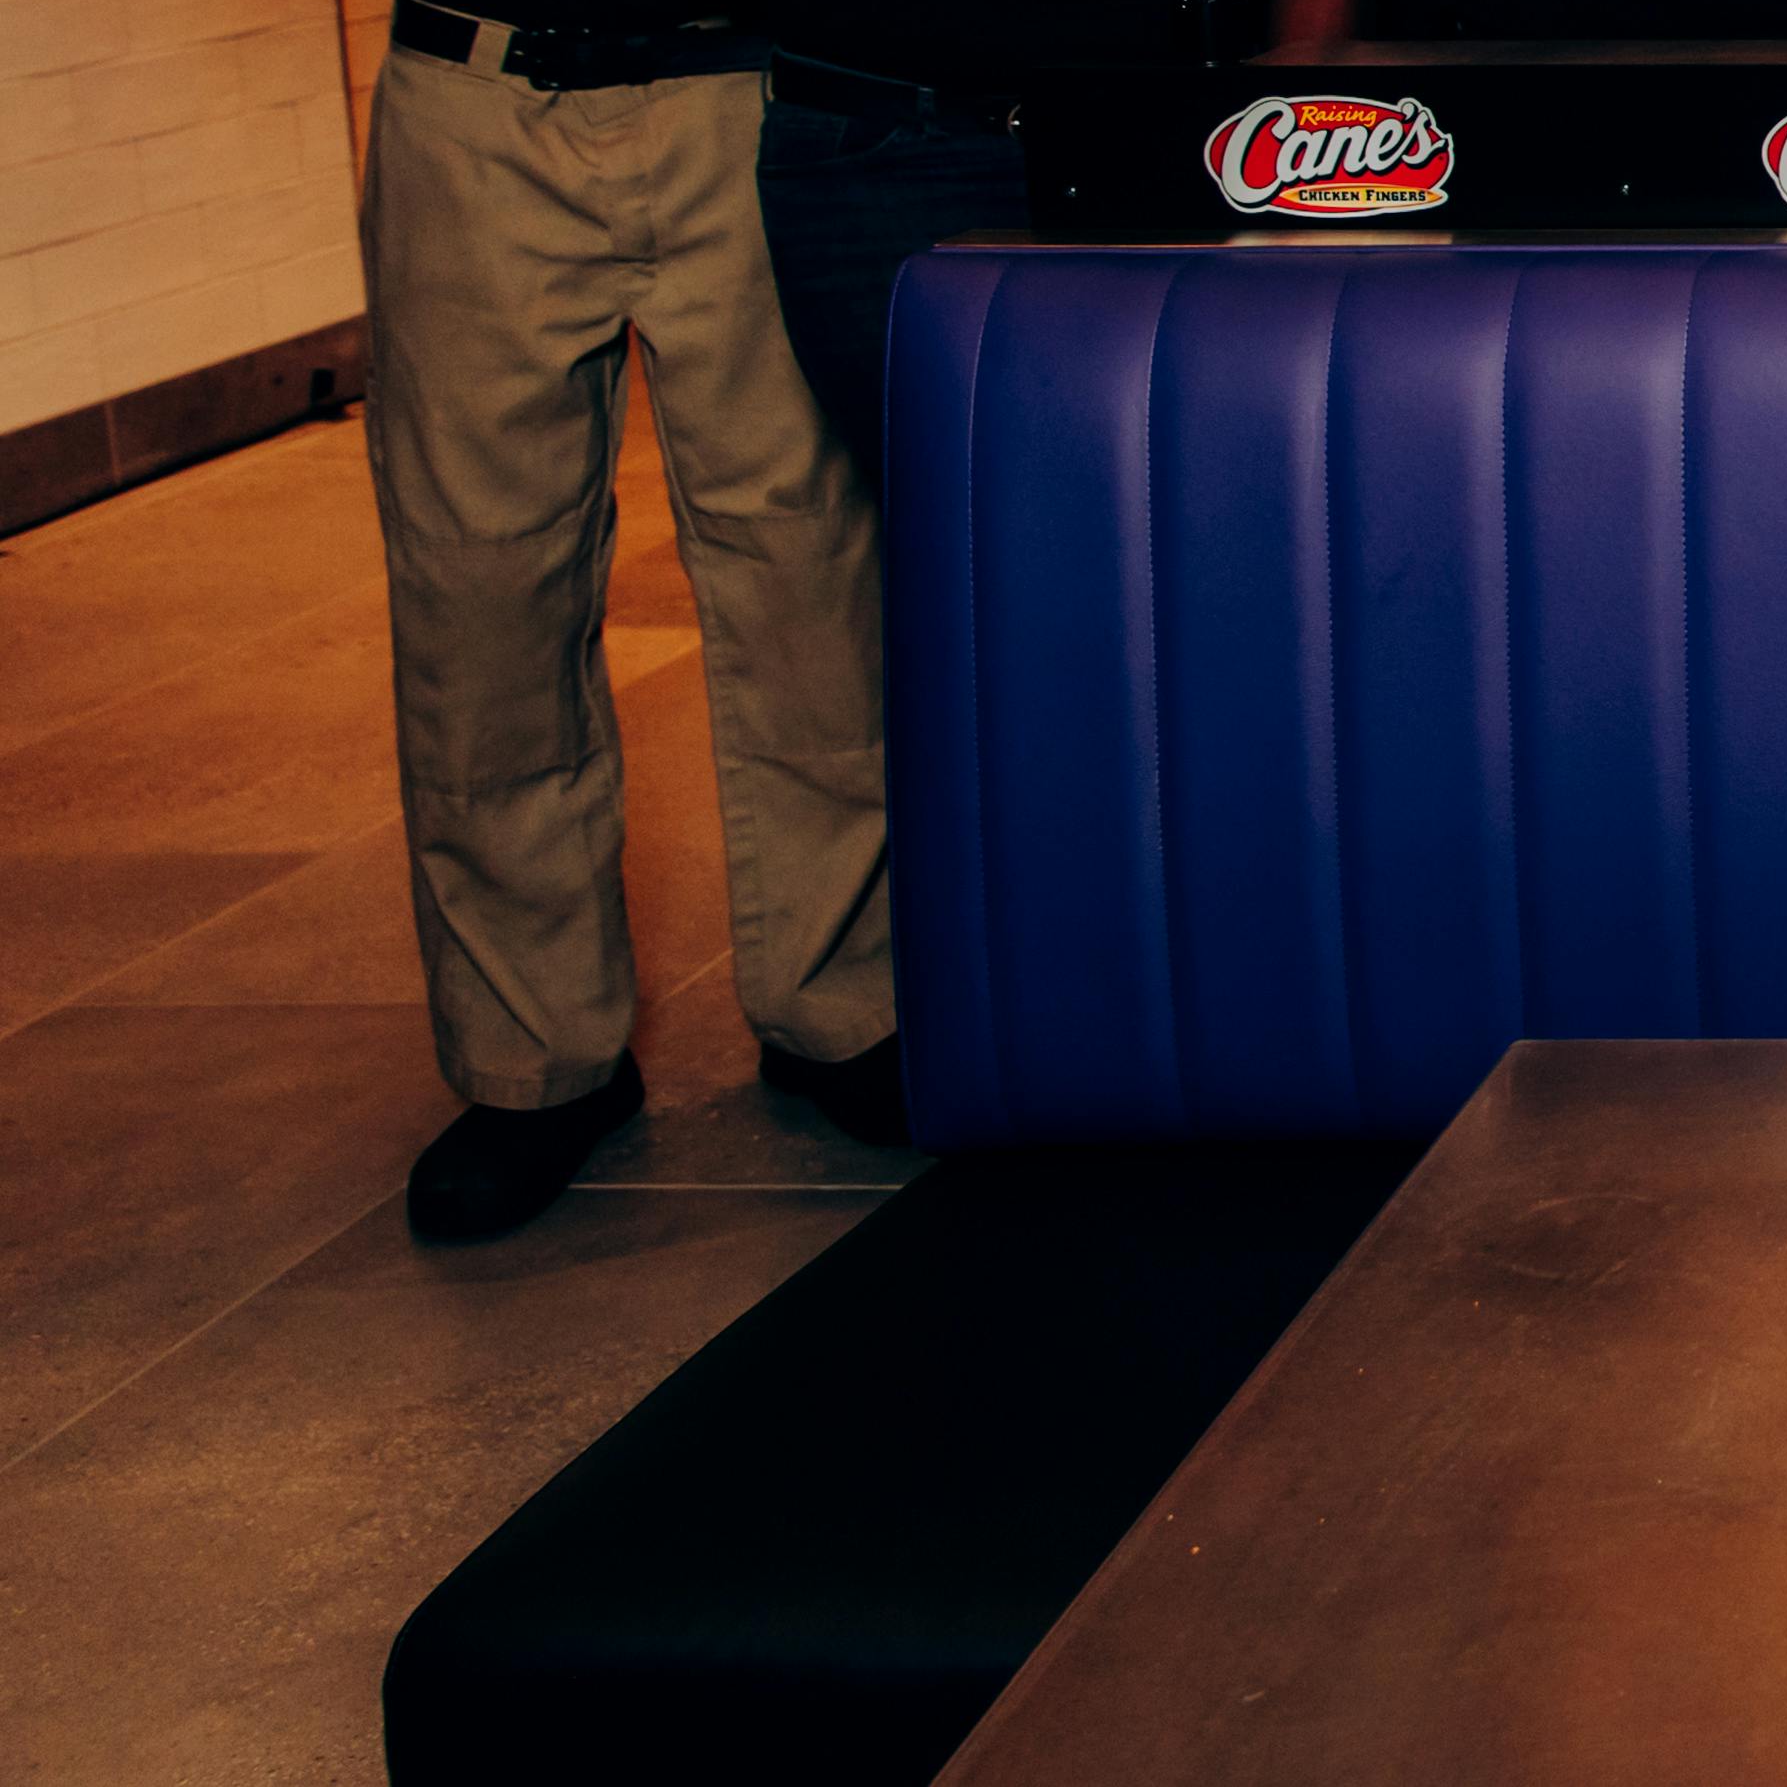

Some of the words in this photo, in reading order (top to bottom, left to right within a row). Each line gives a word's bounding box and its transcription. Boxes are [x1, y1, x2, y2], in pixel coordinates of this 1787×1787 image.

[1300, 105, 1377, 128] Raising
[1222, 99, 1446, 203] Cane's
[1300, 189, 1360, 202] CHICKEN
[1366, 189, 1426, 202] FINGERS
